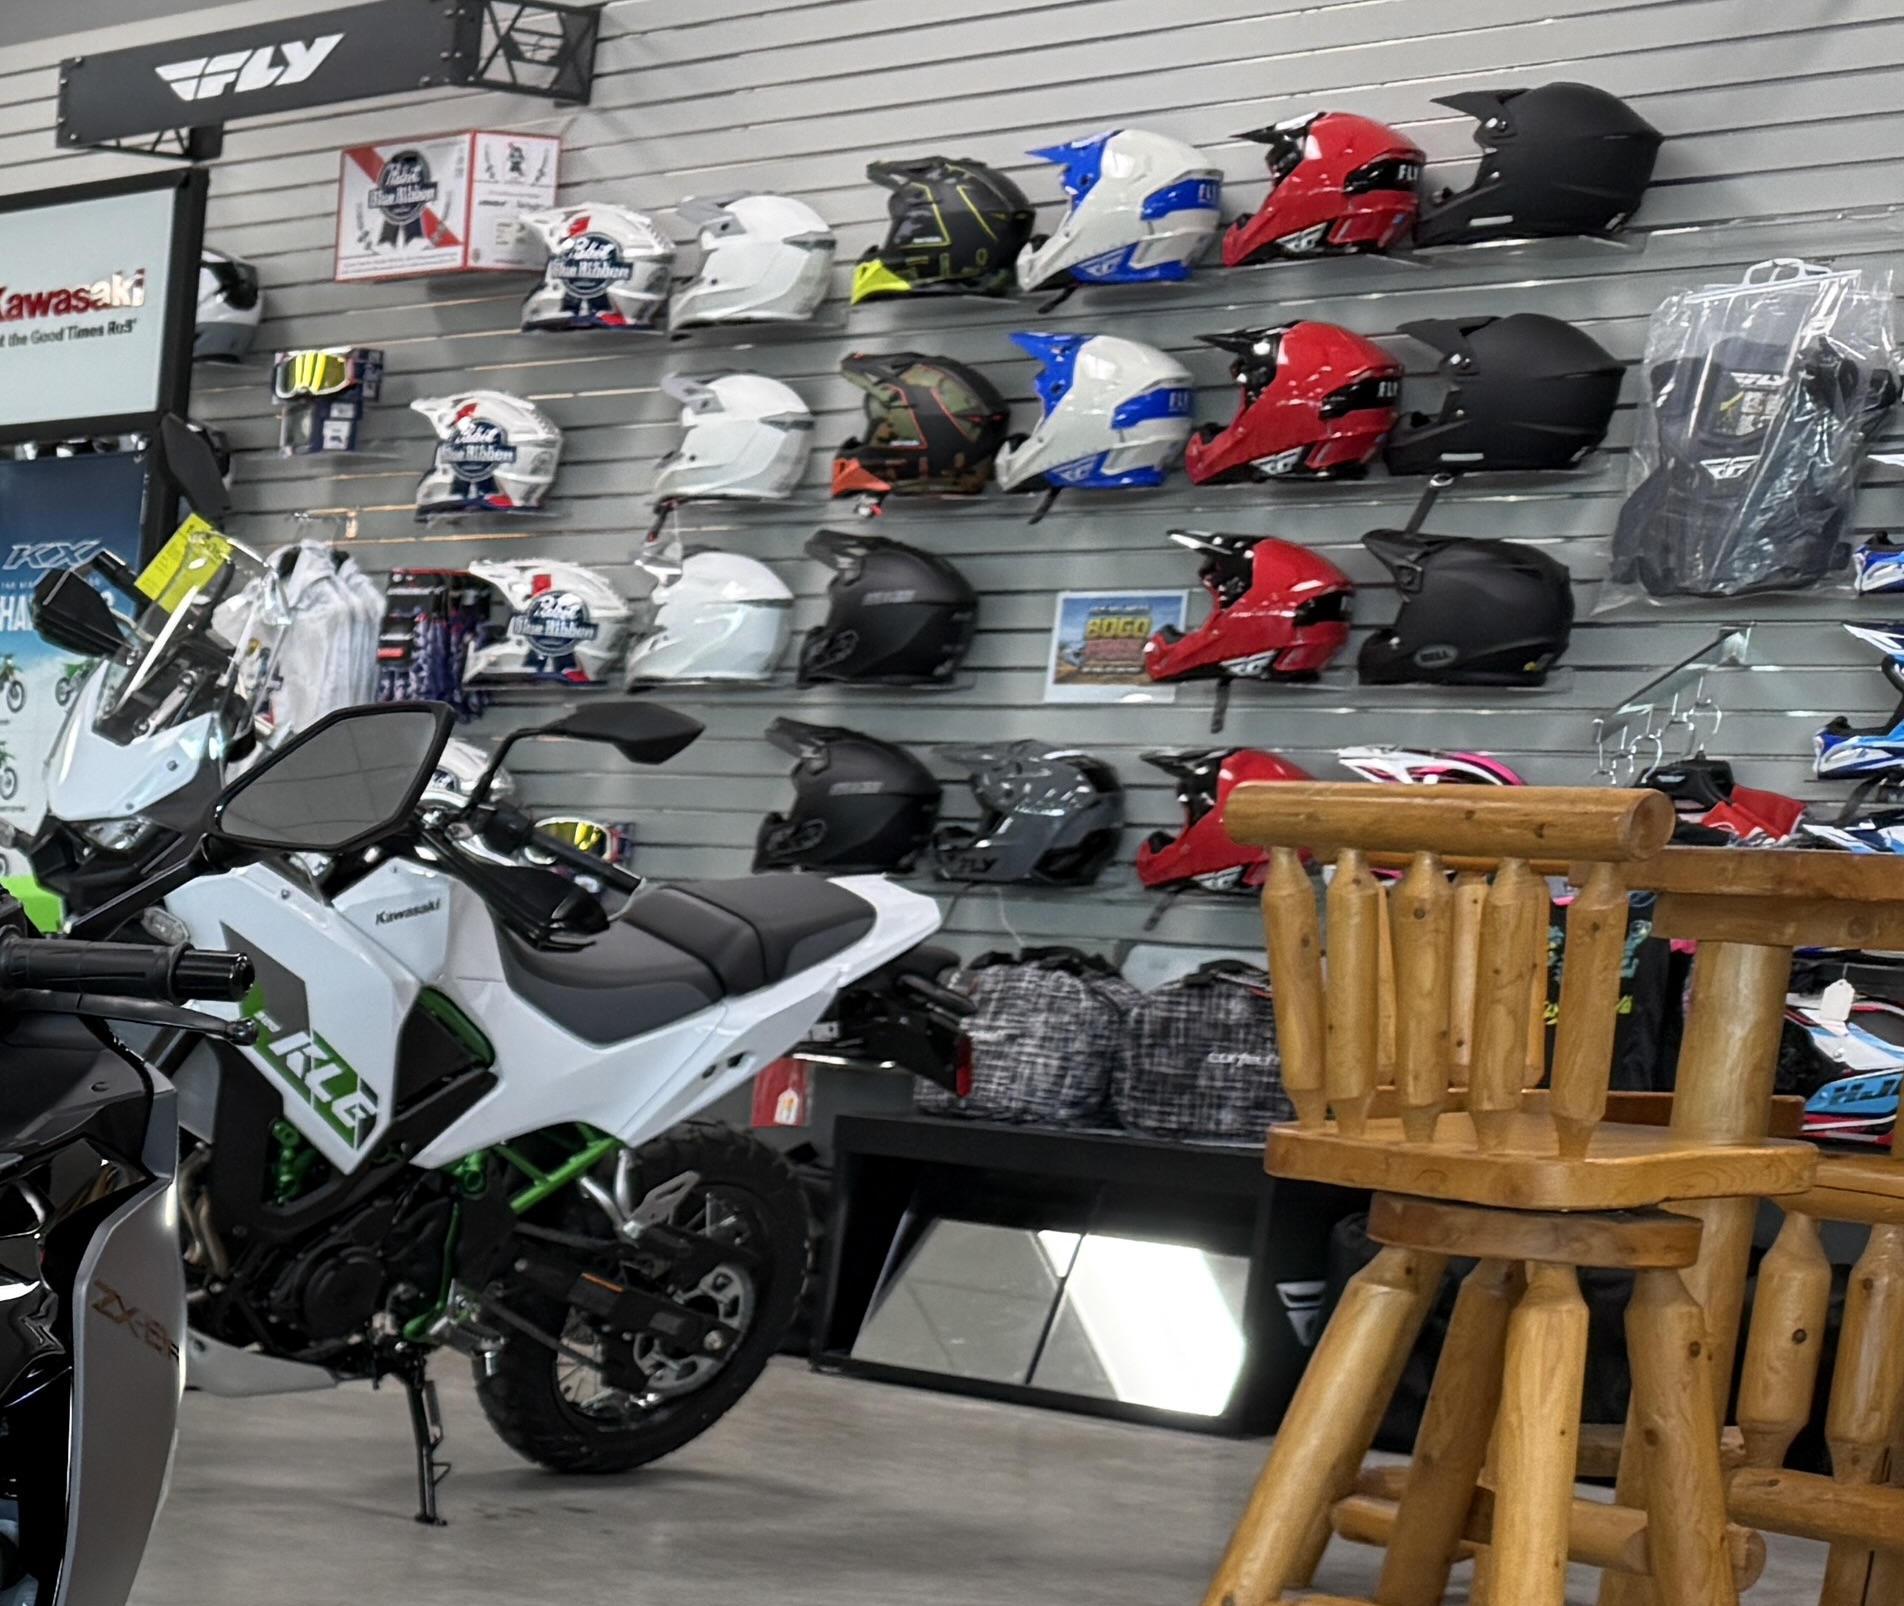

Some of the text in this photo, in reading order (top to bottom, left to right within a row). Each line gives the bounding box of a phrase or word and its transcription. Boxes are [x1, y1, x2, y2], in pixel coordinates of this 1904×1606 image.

[154, 33, 346, 101] FLY
[7, 331, 28, 348] the
[30, 327, 64, 346] Good
[66, 324, 104, 341] Times
[1, 539, 101, 571] KX
[1085, 615, 1152, 638] BOGO
[375, 898, 442, 927] Kawasaki
